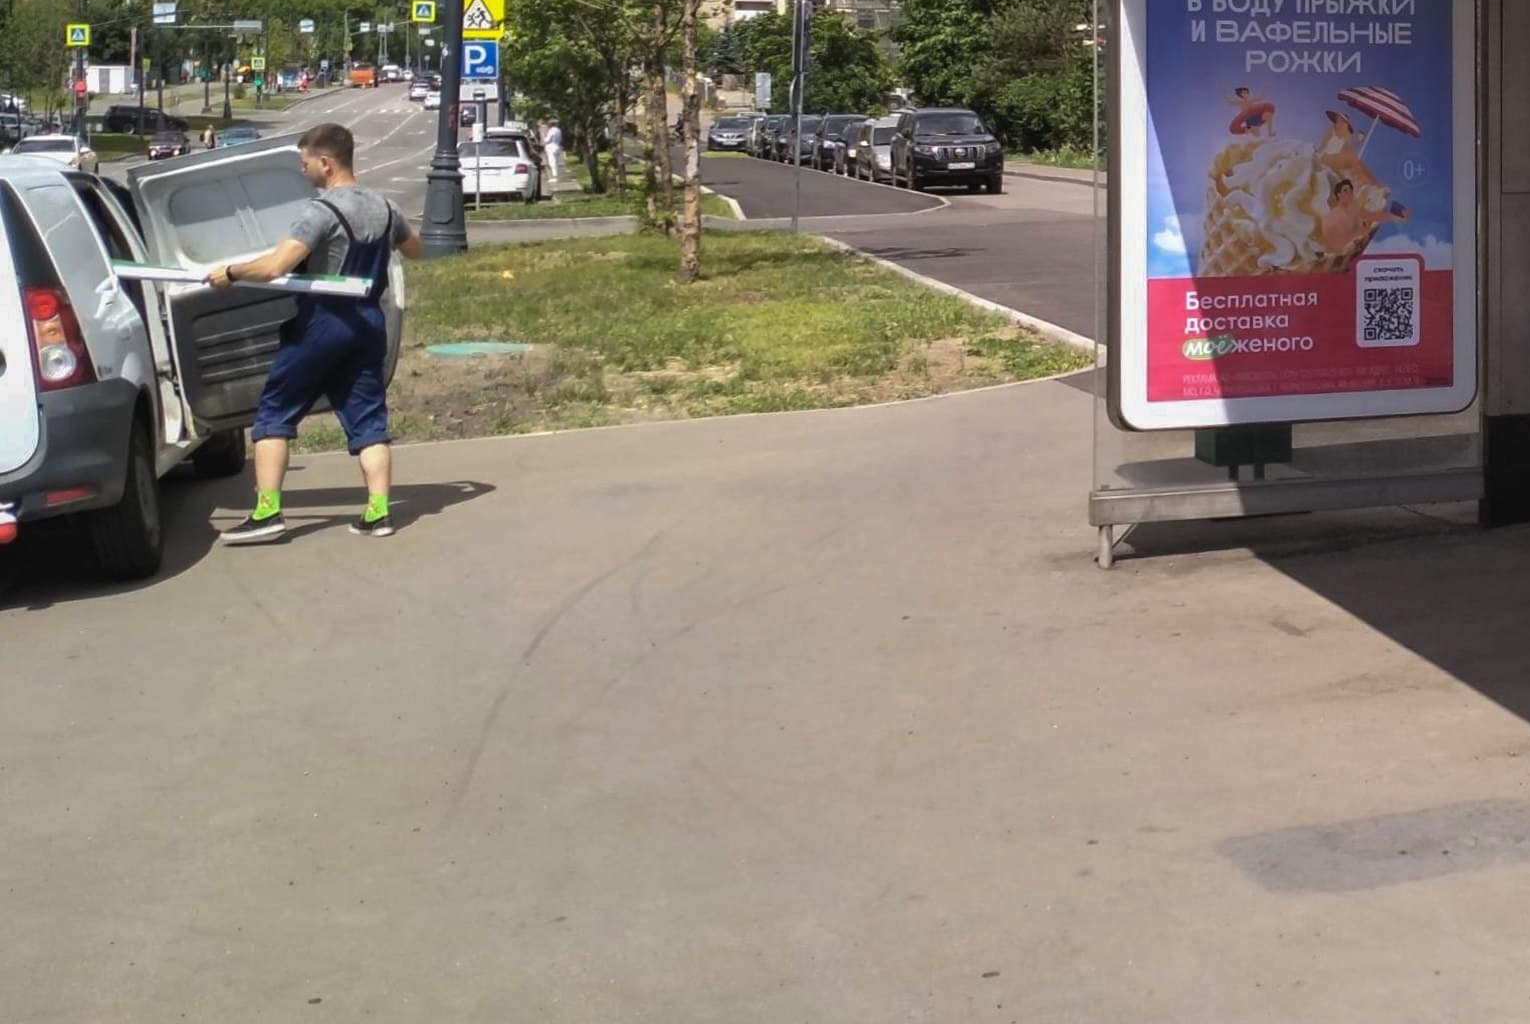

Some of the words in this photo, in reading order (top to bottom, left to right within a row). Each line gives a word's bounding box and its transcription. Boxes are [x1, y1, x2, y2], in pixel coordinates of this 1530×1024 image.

[1191, 20, 1206, 43] И
[1216, 20, 1412, 44] ВАФЕЛЬНЫЕ
[464, 45, 487, 74] P
[1246, 51, 1361, 73] РОЖКИ
[1403, 160, 1425, 180] 0+
[1185, 291, 1318, 310] Бесплатная
[1184, 314, 1289, 334] доставка
